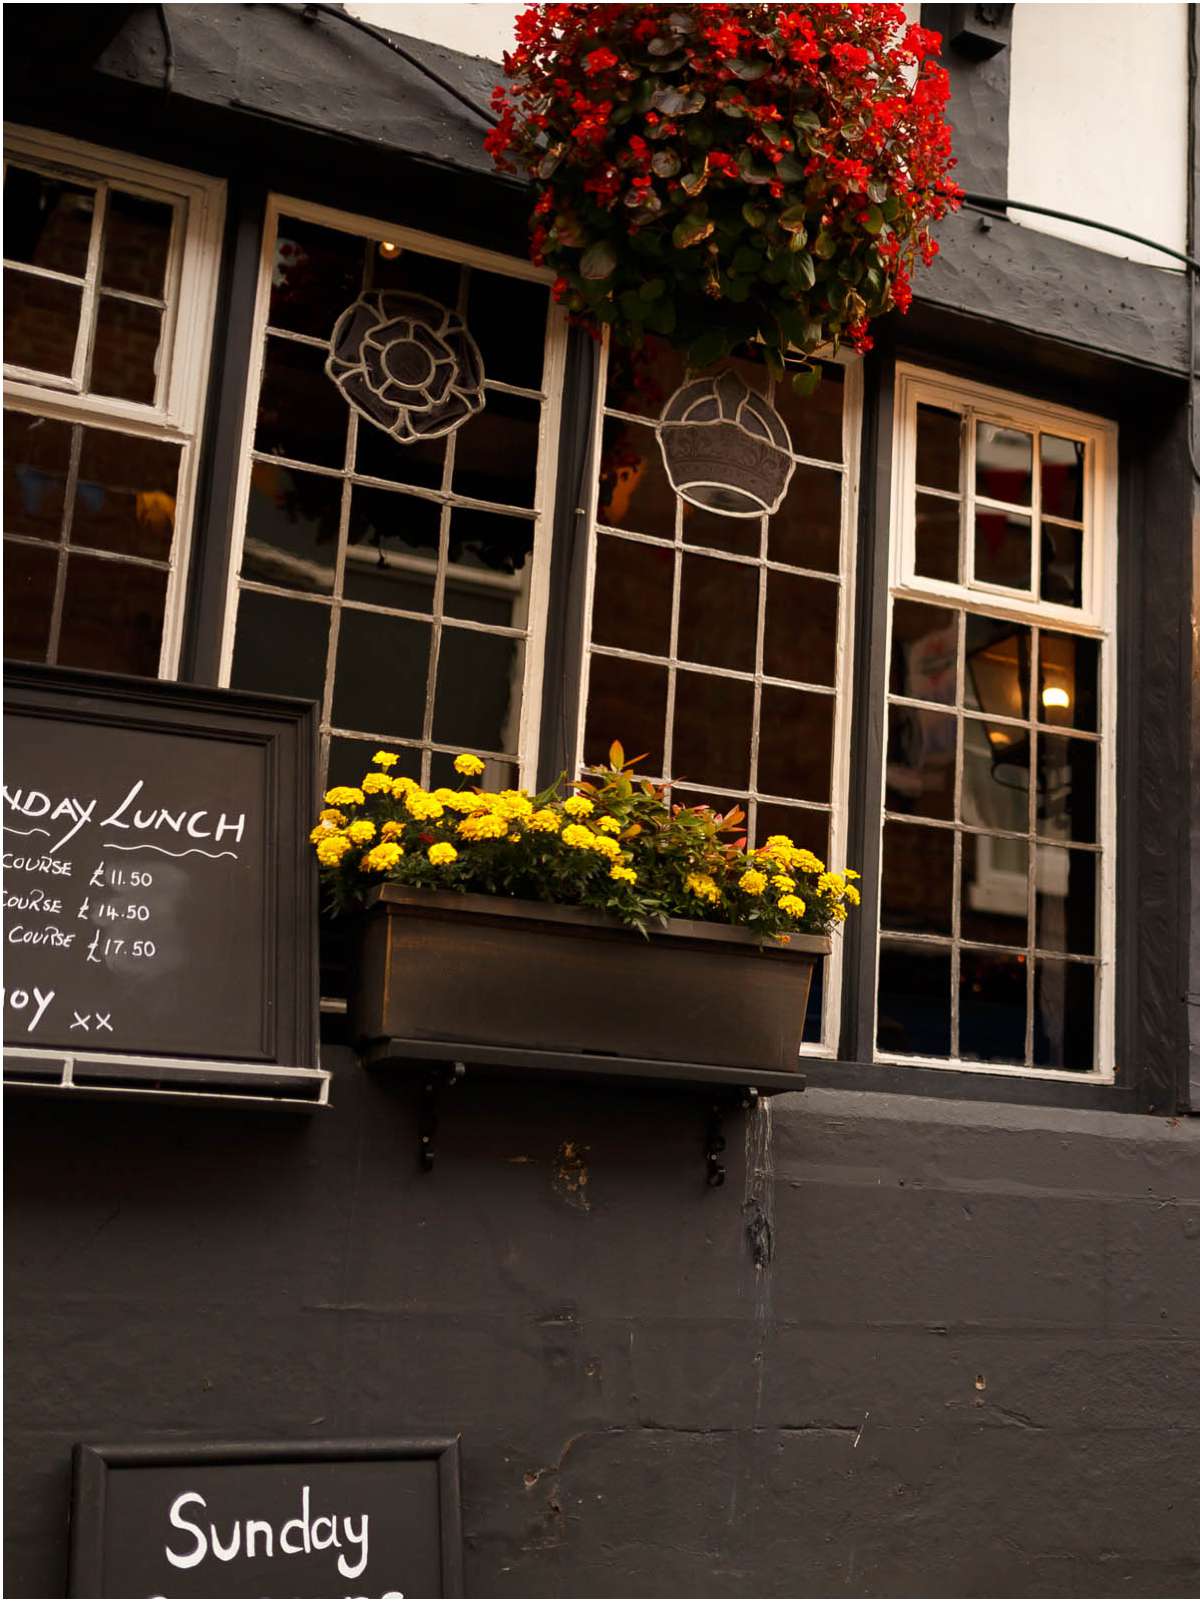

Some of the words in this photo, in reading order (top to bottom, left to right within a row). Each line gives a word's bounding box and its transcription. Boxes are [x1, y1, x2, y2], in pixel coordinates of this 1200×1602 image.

[99, 779, 246, 843] LUNCH
[3, 853, 72, 877] COURSE
[8, 925, 76, 948] COURSE
[164, 1485, 369, 1579] Sunday
